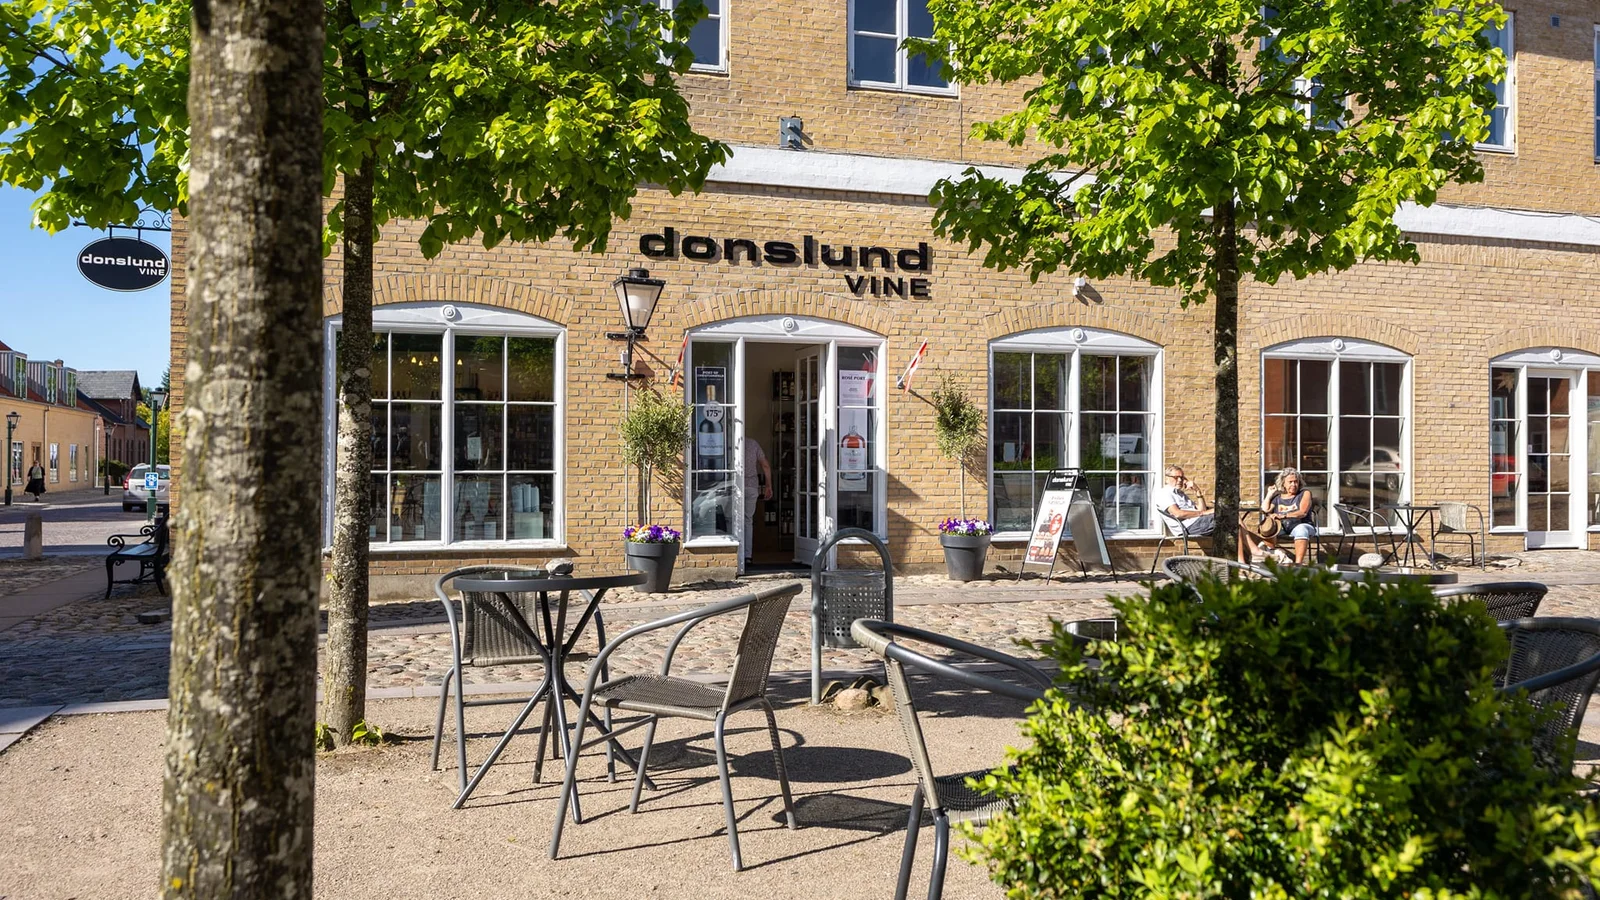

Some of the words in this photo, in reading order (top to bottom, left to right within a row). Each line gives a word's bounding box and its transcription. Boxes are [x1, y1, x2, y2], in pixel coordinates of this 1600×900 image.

[639, 227, 928, 271] donslund
[81, 253, 166, 268] donslund
[139, 268, 165, 276] VINE
[844, 275, 929, 297] VINE
